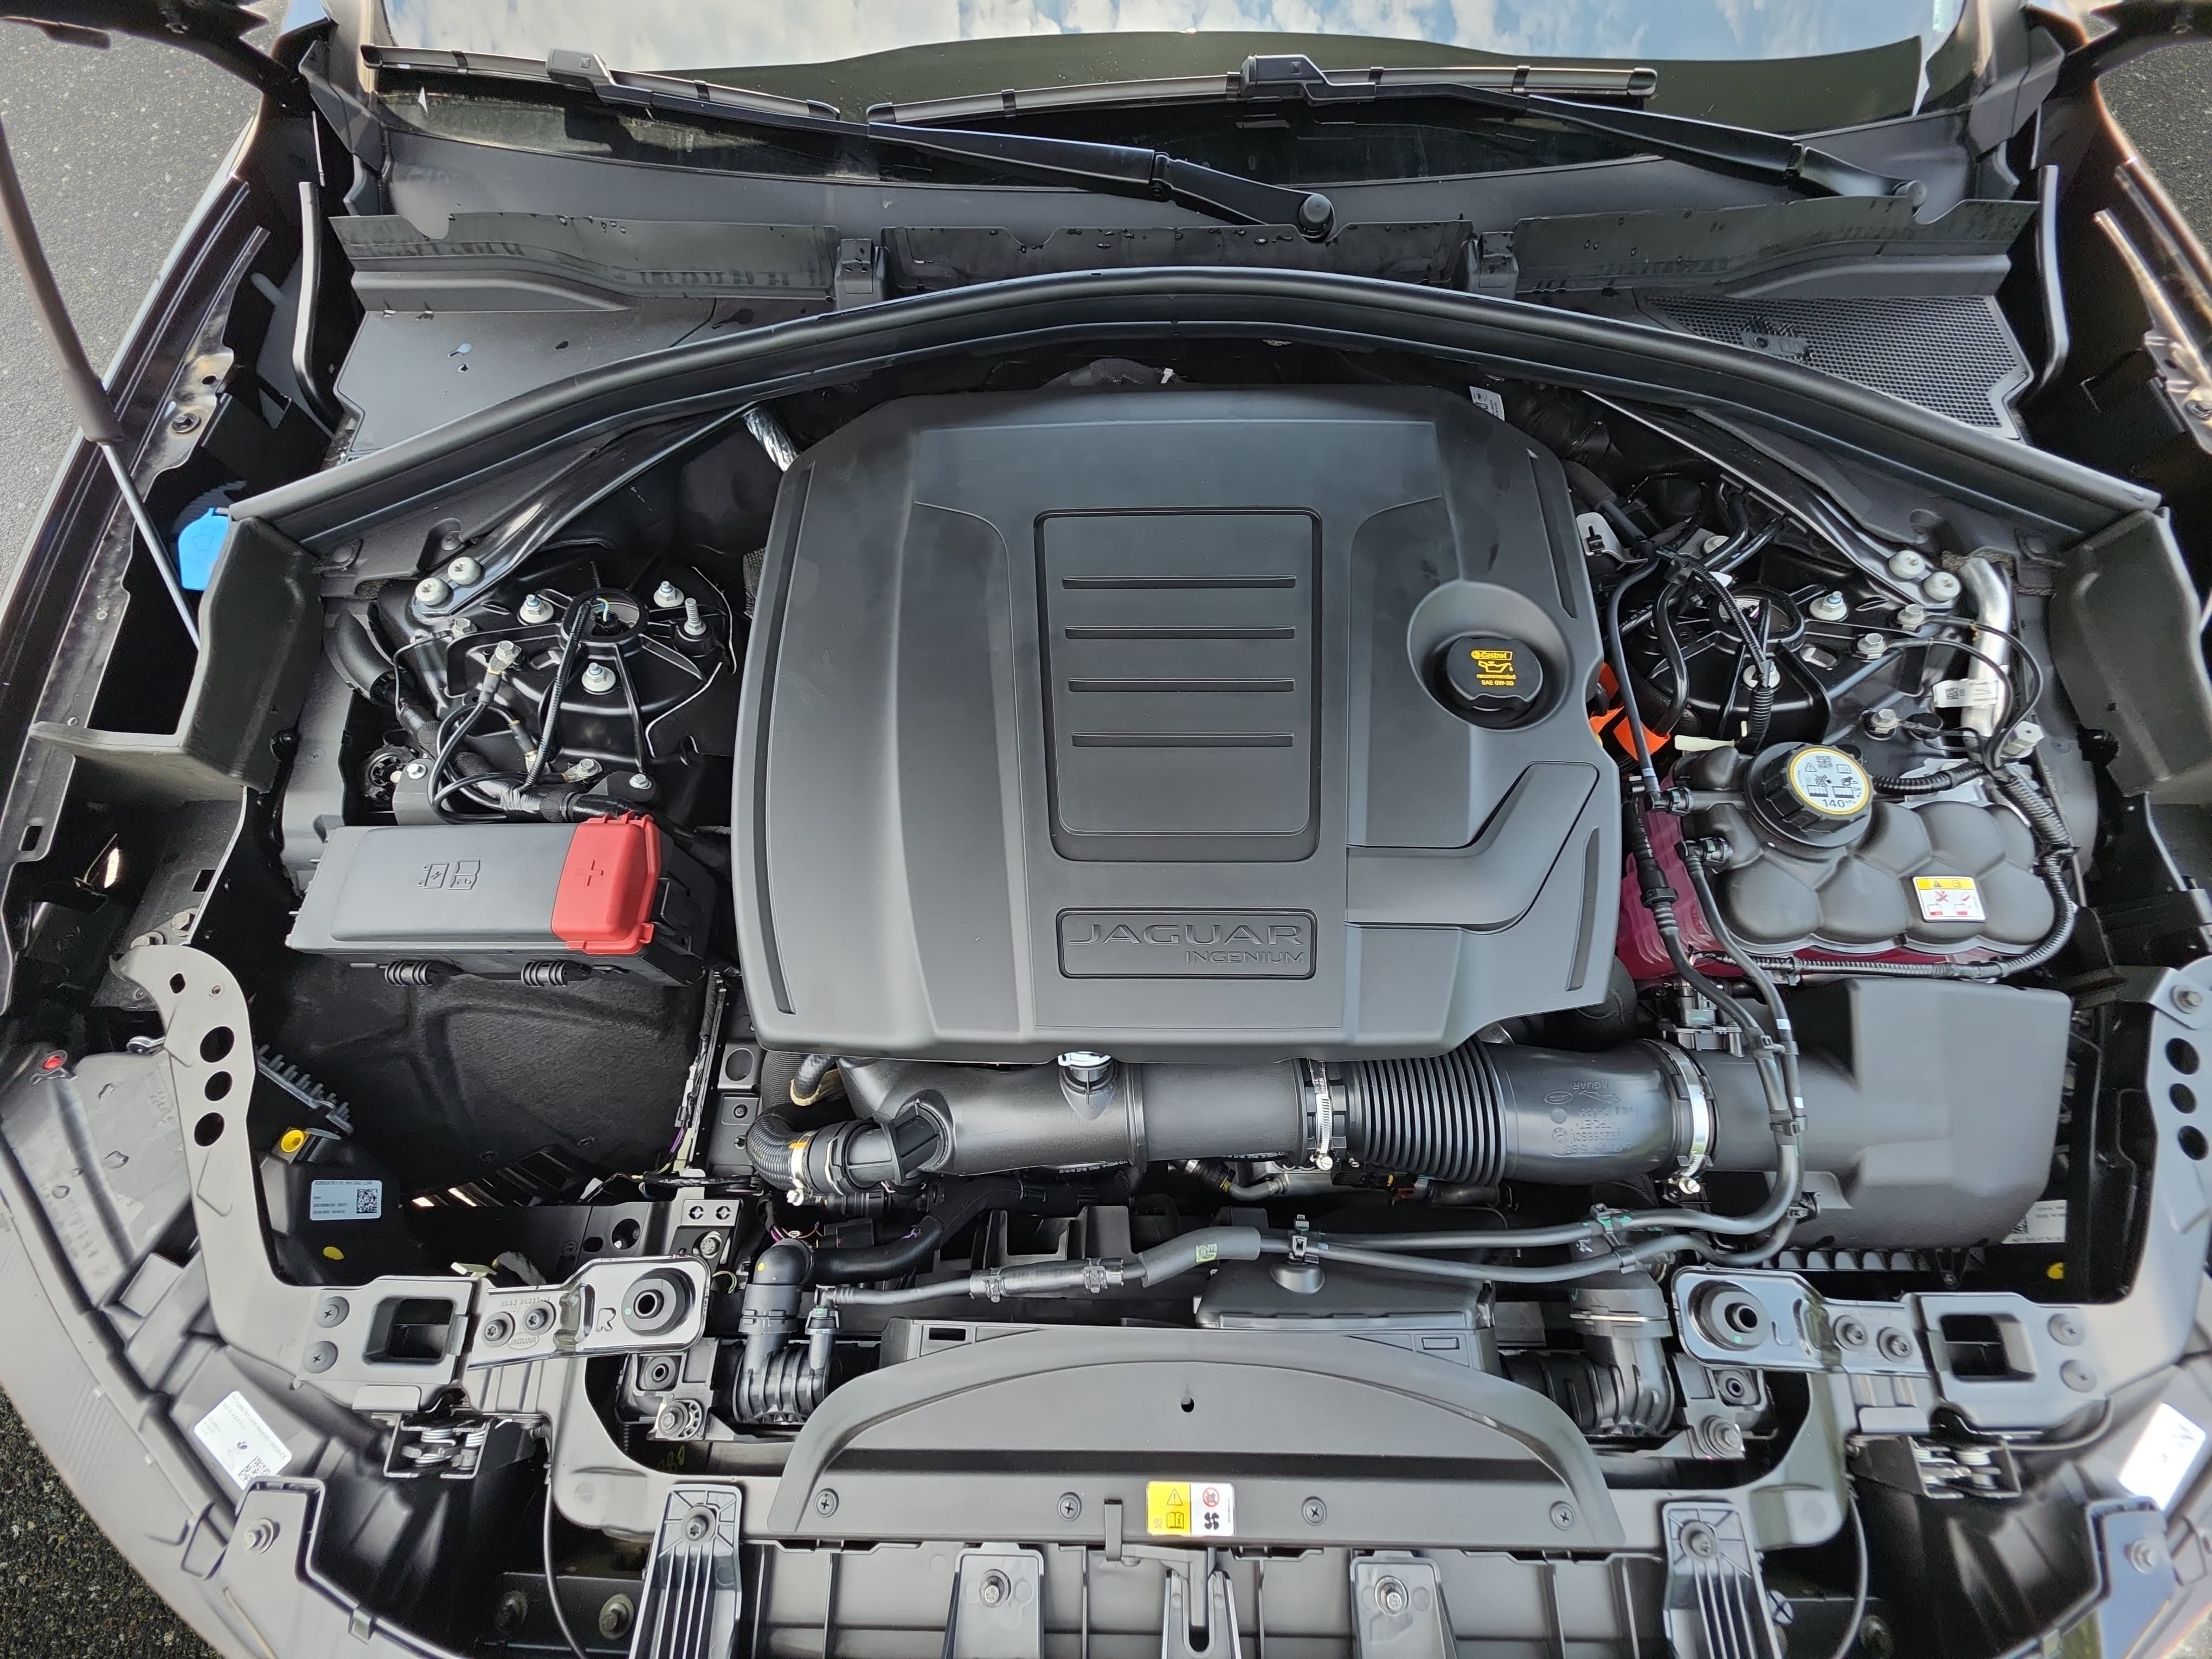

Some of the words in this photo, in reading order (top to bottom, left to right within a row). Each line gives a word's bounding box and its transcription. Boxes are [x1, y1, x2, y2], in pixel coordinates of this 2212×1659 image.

[1822, 799, 1845, 808] 140
[1069, 924, 1304, 946] JAGUAR
[1185, 950, 1304, 964] INGENIUM
[1572, 1081, 1610, 1090] JAGUAR
[596, 1307, 616, 1332] R
[510, 1337, 537, 1345] JAGUAR
